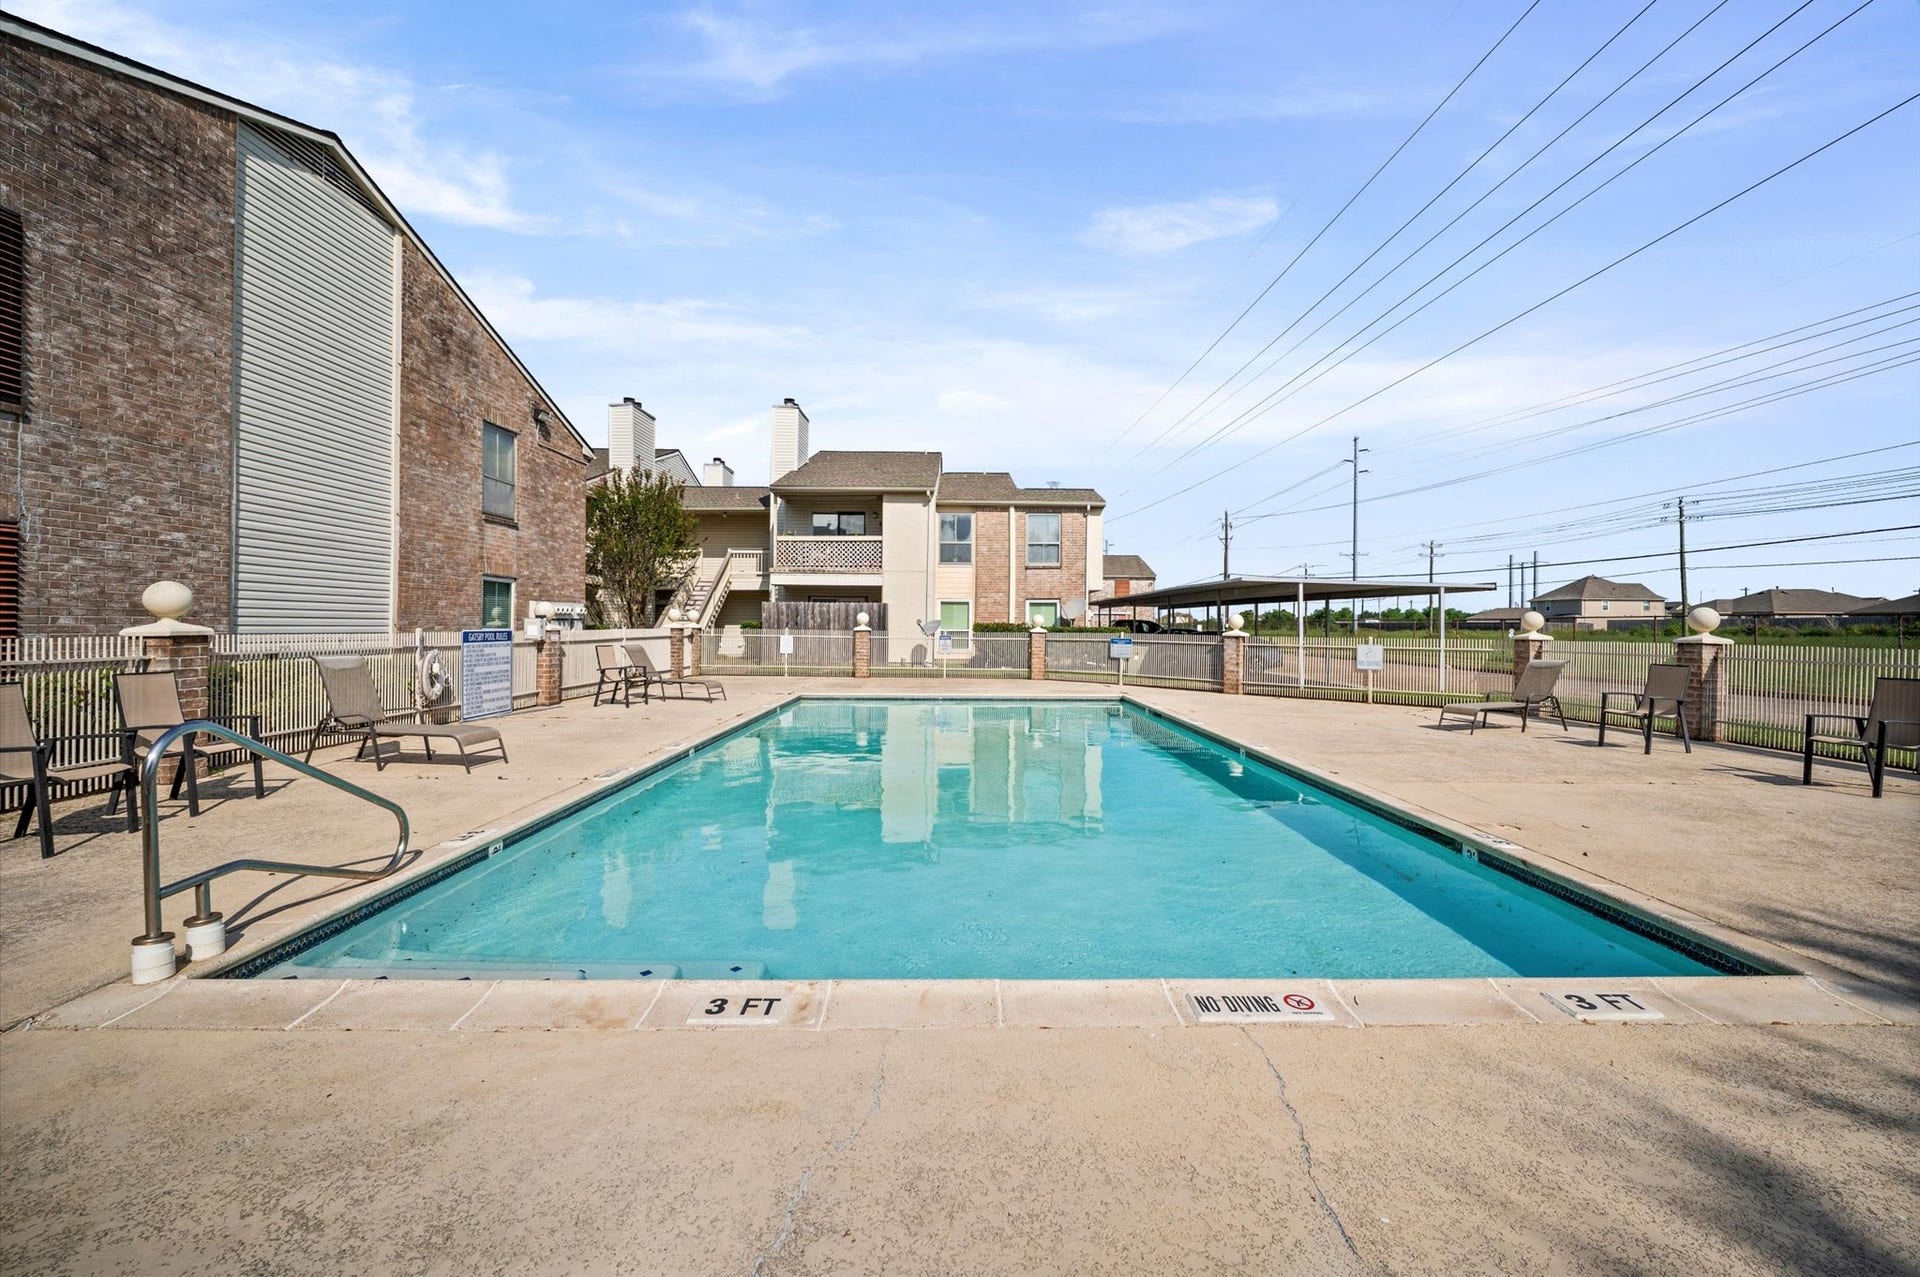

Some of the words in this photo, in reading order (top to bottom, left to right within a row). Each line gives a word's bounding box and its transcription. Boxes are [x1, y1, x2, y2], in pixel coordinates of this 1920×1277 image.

[468, 632, 484, 641] GATSBY
[485, 632, 495, 641] POOL
[496, 632, 508, 640] RULES
[704, 998, 728, 1015] 3
[739, 998, 782, 1015] FT
[1194, 996, 1221, 1012] NO
[1221, 996, 1281, 1012] DIVING
[1564, 994, 1598, 1010] 3
[1595, 994, 1646, 1010] FT
